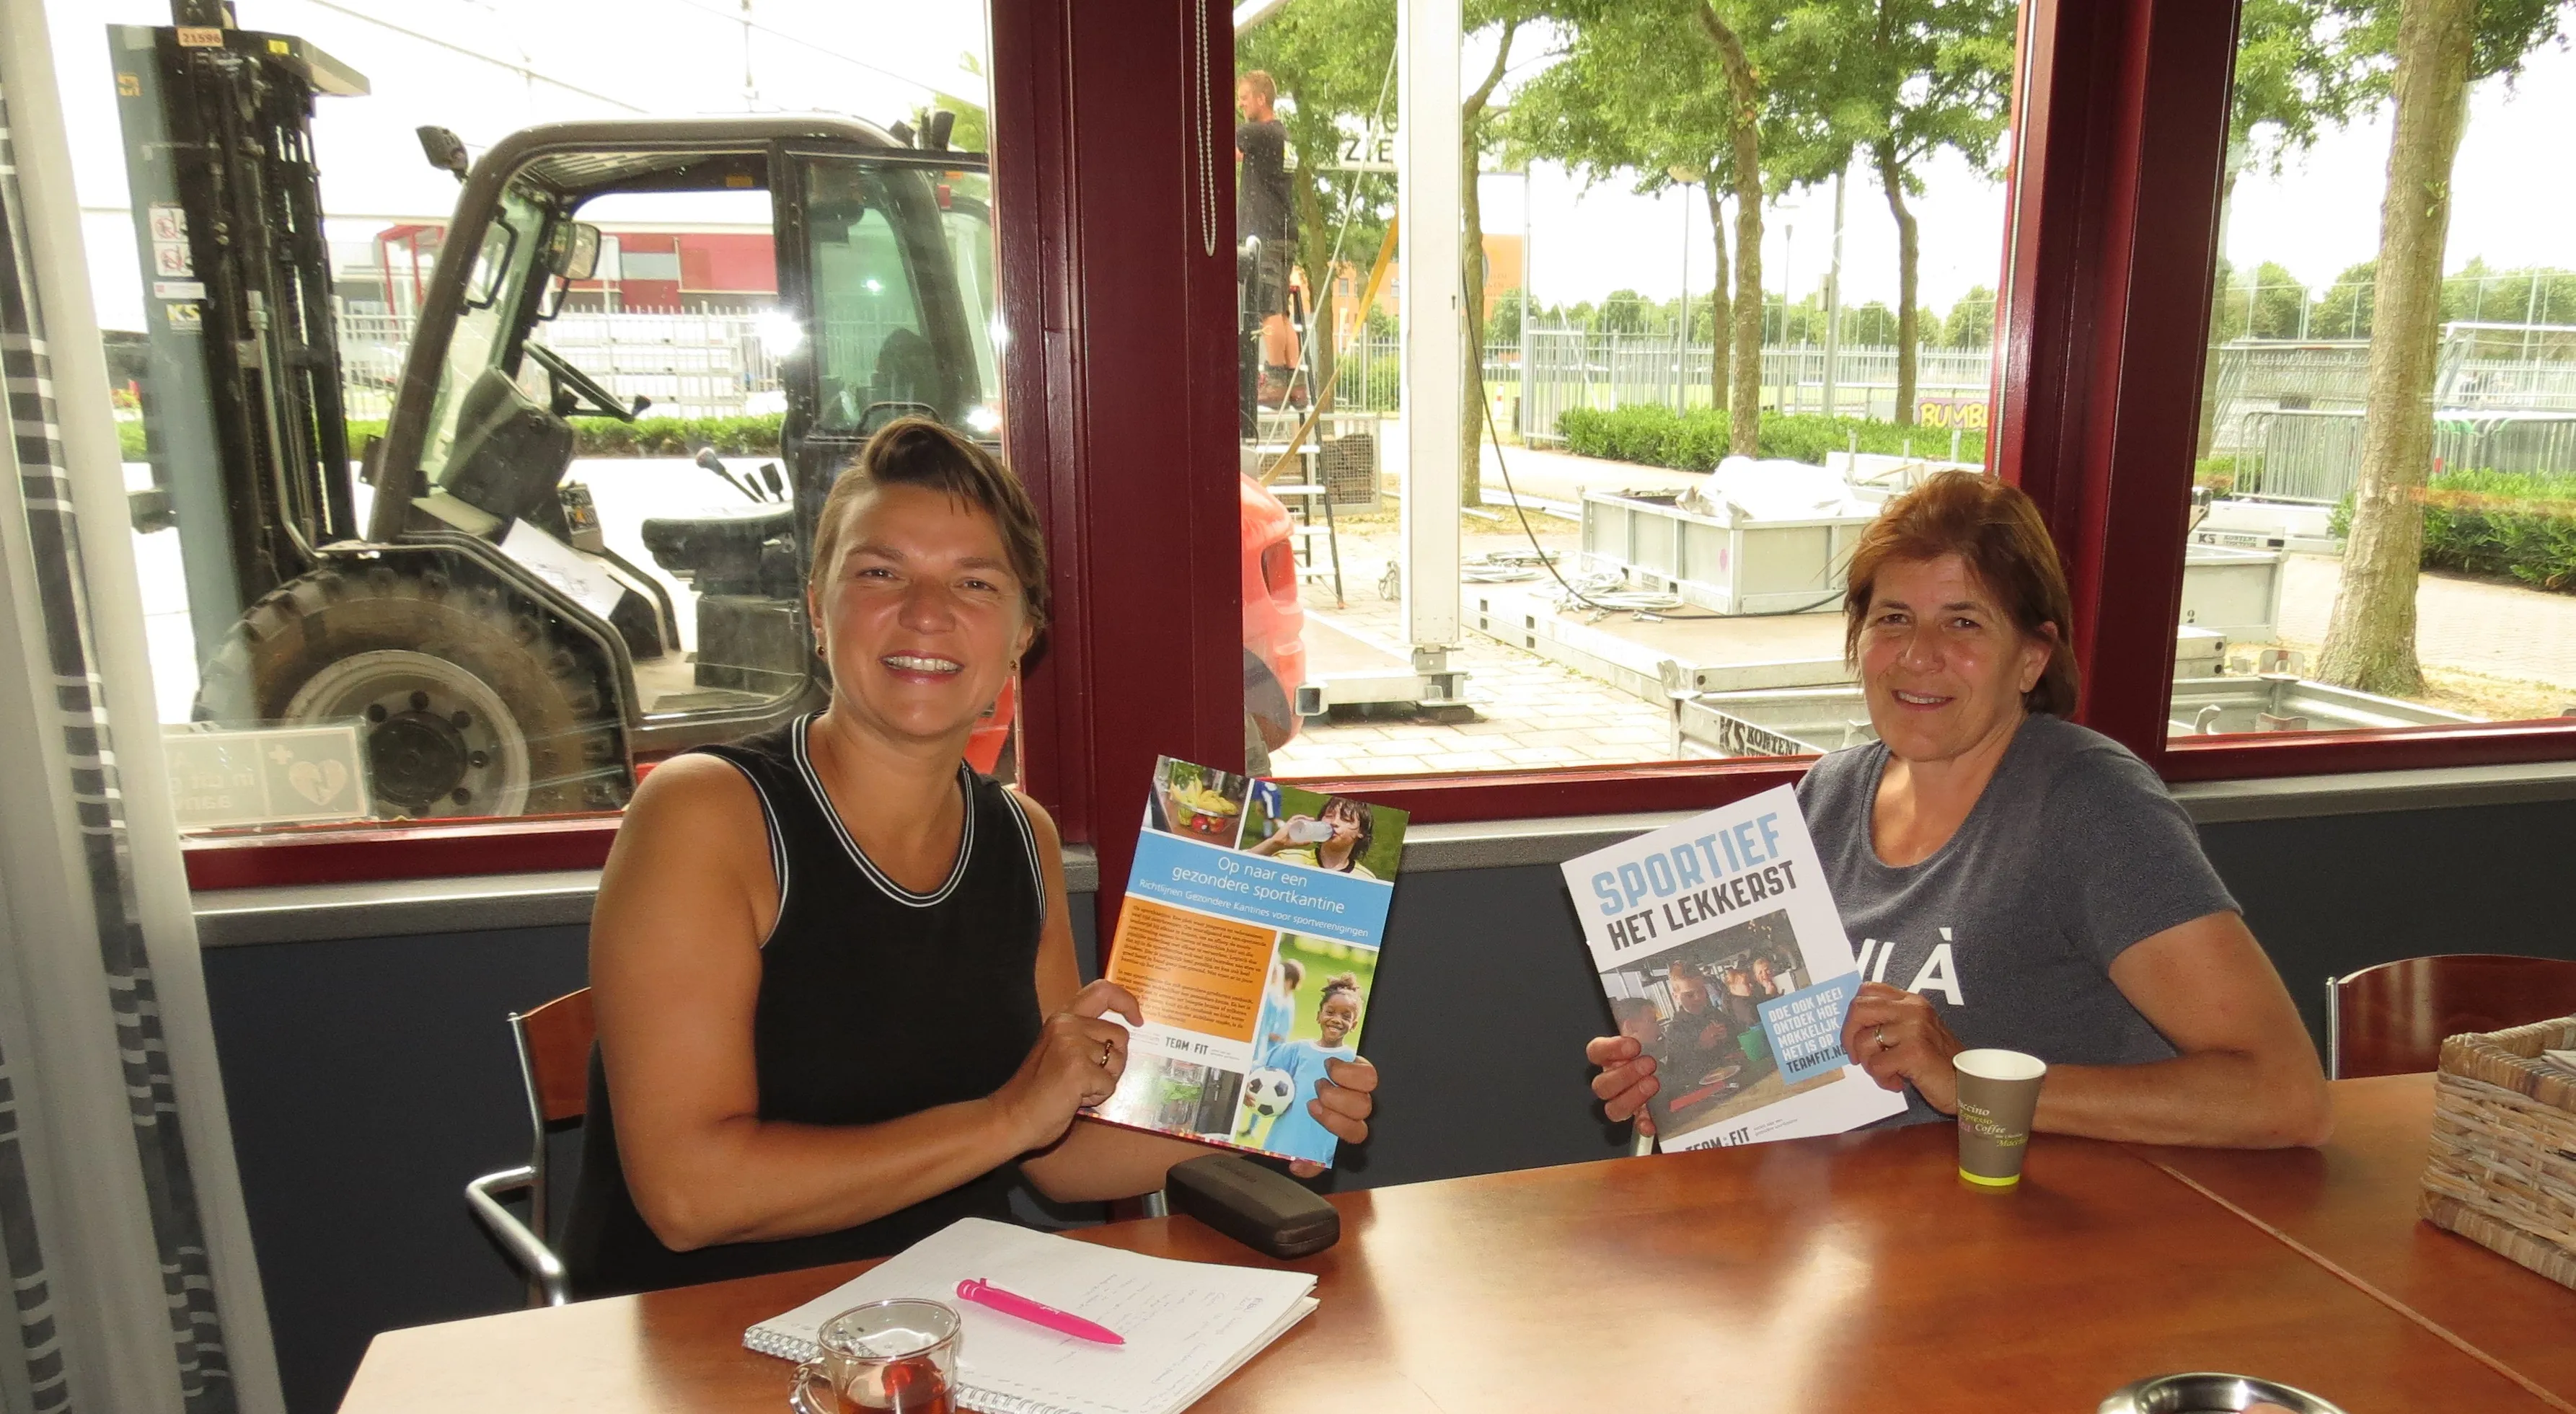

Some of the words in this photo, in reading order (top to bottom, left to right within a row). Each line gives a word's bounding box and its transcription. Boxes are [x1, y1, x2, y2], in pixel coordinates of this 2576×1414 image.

[2198, 533, 2217, 545] KS
[2187, 609, 2195, 624] 2
[1217, 856, 1240, 875] Op
[1244, 864, 1278, 882] naar
[1280, 872, 1308, 888] een
[1591, 811, 1780, 916] SPORTIEF
[1171, 865, 1250, 894] gezondere
[1252, 884, 1346, 914] sportkantine
[1606, 909, 1658, 951] HET
[1662, 860, 1797, 932] LEKKERST
[1139, 878, 1183, 898] Richtlijnen
[1185, 890, 1232, 909] Gezondere
[1232, 901, 1270, 918] Kantines
[1271, 911, 1291, 922] voor
[1292, 915, 1369, 938] sportverenigingen
[1768, 1004, 1791, 1023] DOE
[1791, 997, 1816, 1015] OOK
[1815, 986, 1844, 1006] MEE!
[1773, 1010, 1817, 1035] ONTDEK
[1816, 1002, 1841, 1020] HOE
[1776, 1017, 1841, 1049] MAKKELIJK
[1781, 1043, 1804, 1061] HET
[1804, 1039, 1817, 1053] IS
[1818, 1033, 1835, 1049] OP
[1975, 1123, 2006, 1135] Coffee
